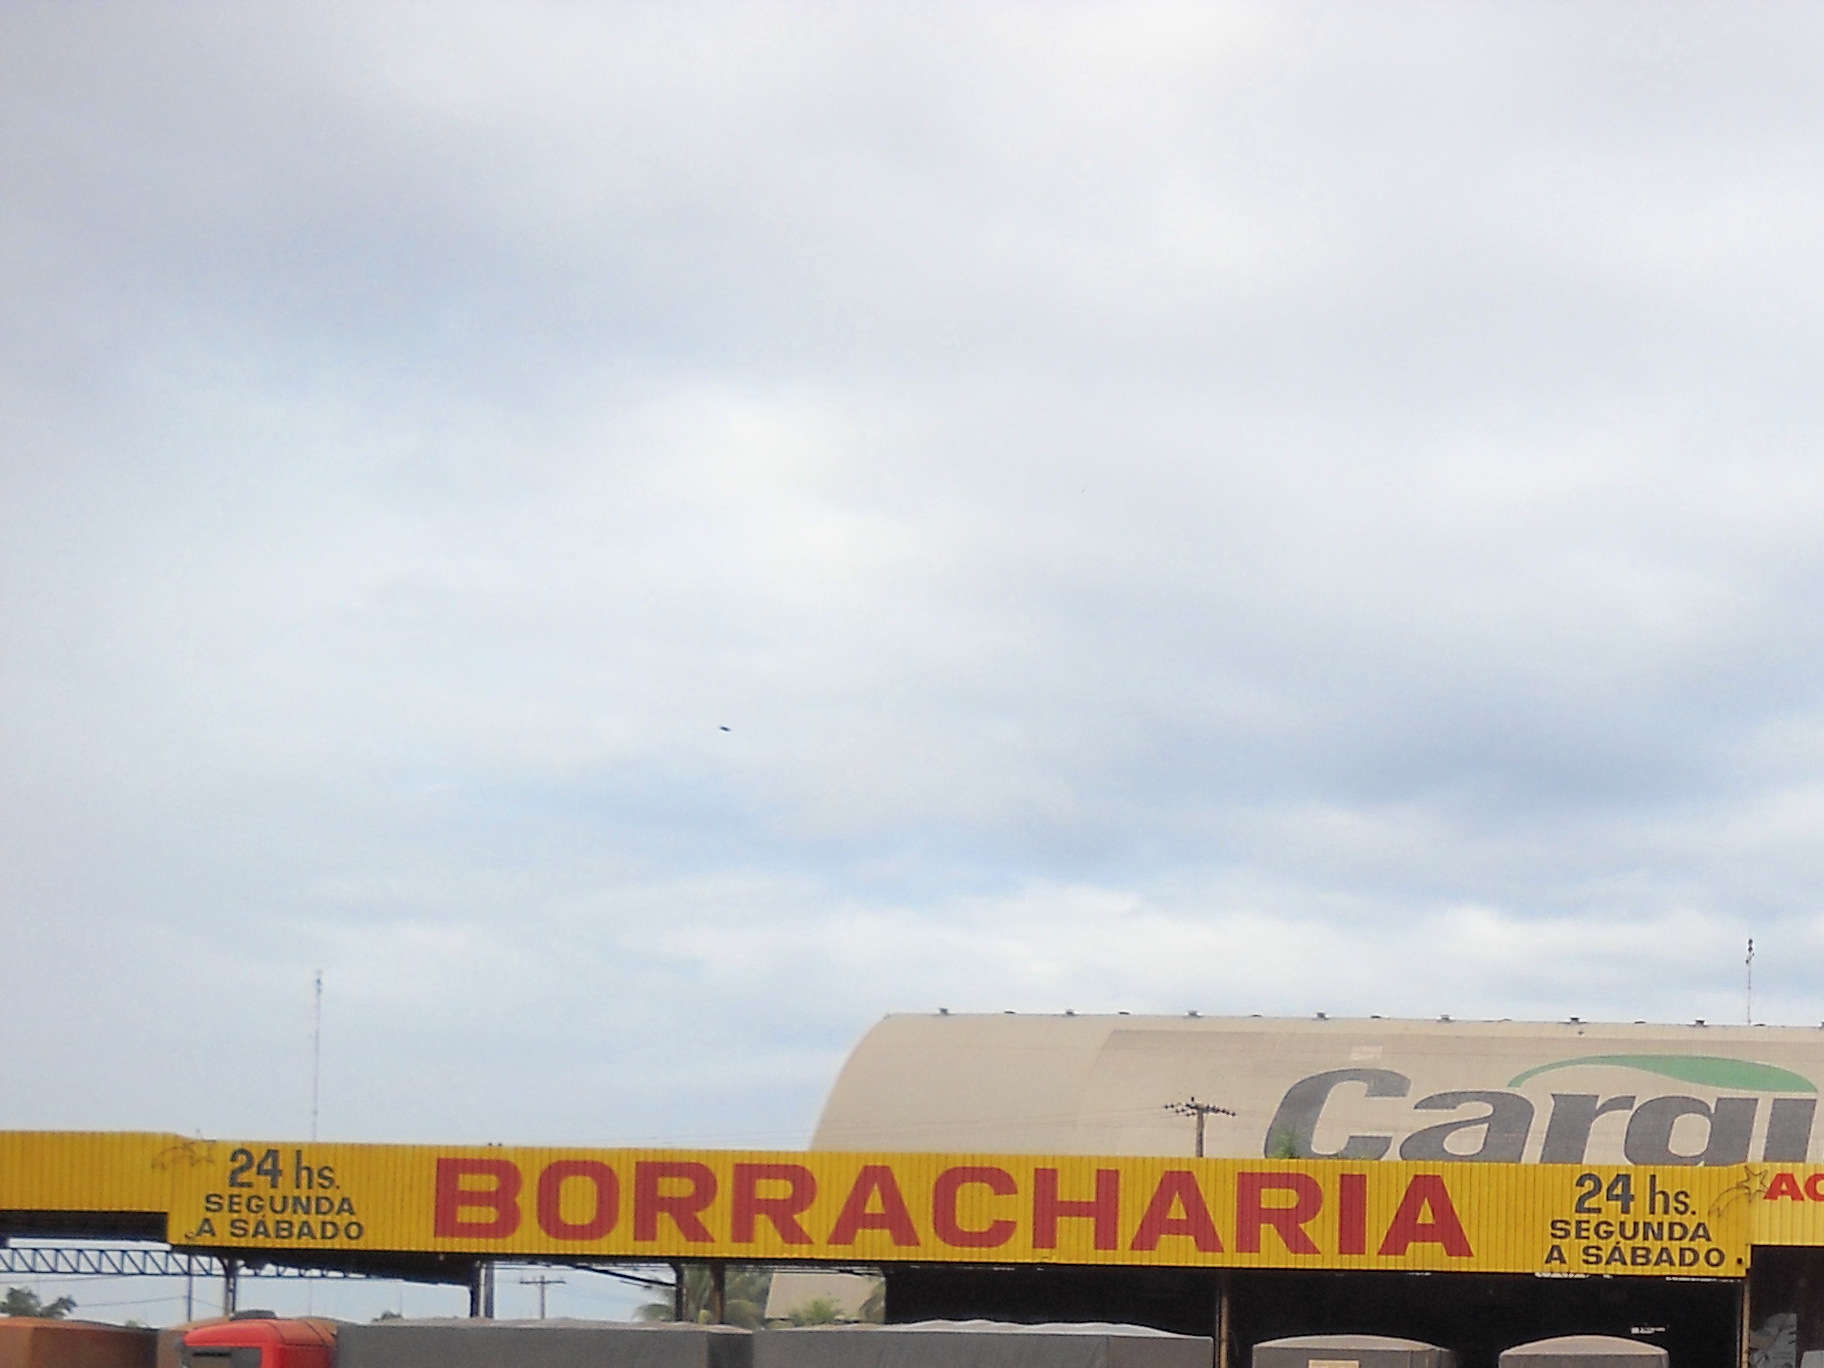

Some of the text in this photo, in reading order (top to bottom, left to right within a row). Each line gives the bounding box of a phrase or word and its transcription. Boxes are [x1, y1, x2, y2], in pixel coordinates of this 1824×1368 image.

[229, 1148, 341, 1190] 24 hs.
[204, 1193, 357, 1216] SEGUNDA
[1574, 1172, 1697, 1216] 24 hs.
[433, 1157, 1475, 1259] BORRACHARIA
[195, 1214, 365, 1240] A SÁBADO
[1550, 1219, 1713, 1242] SEGUNDA
[1544, 1241, 1726, 1268] A SÁBADO
